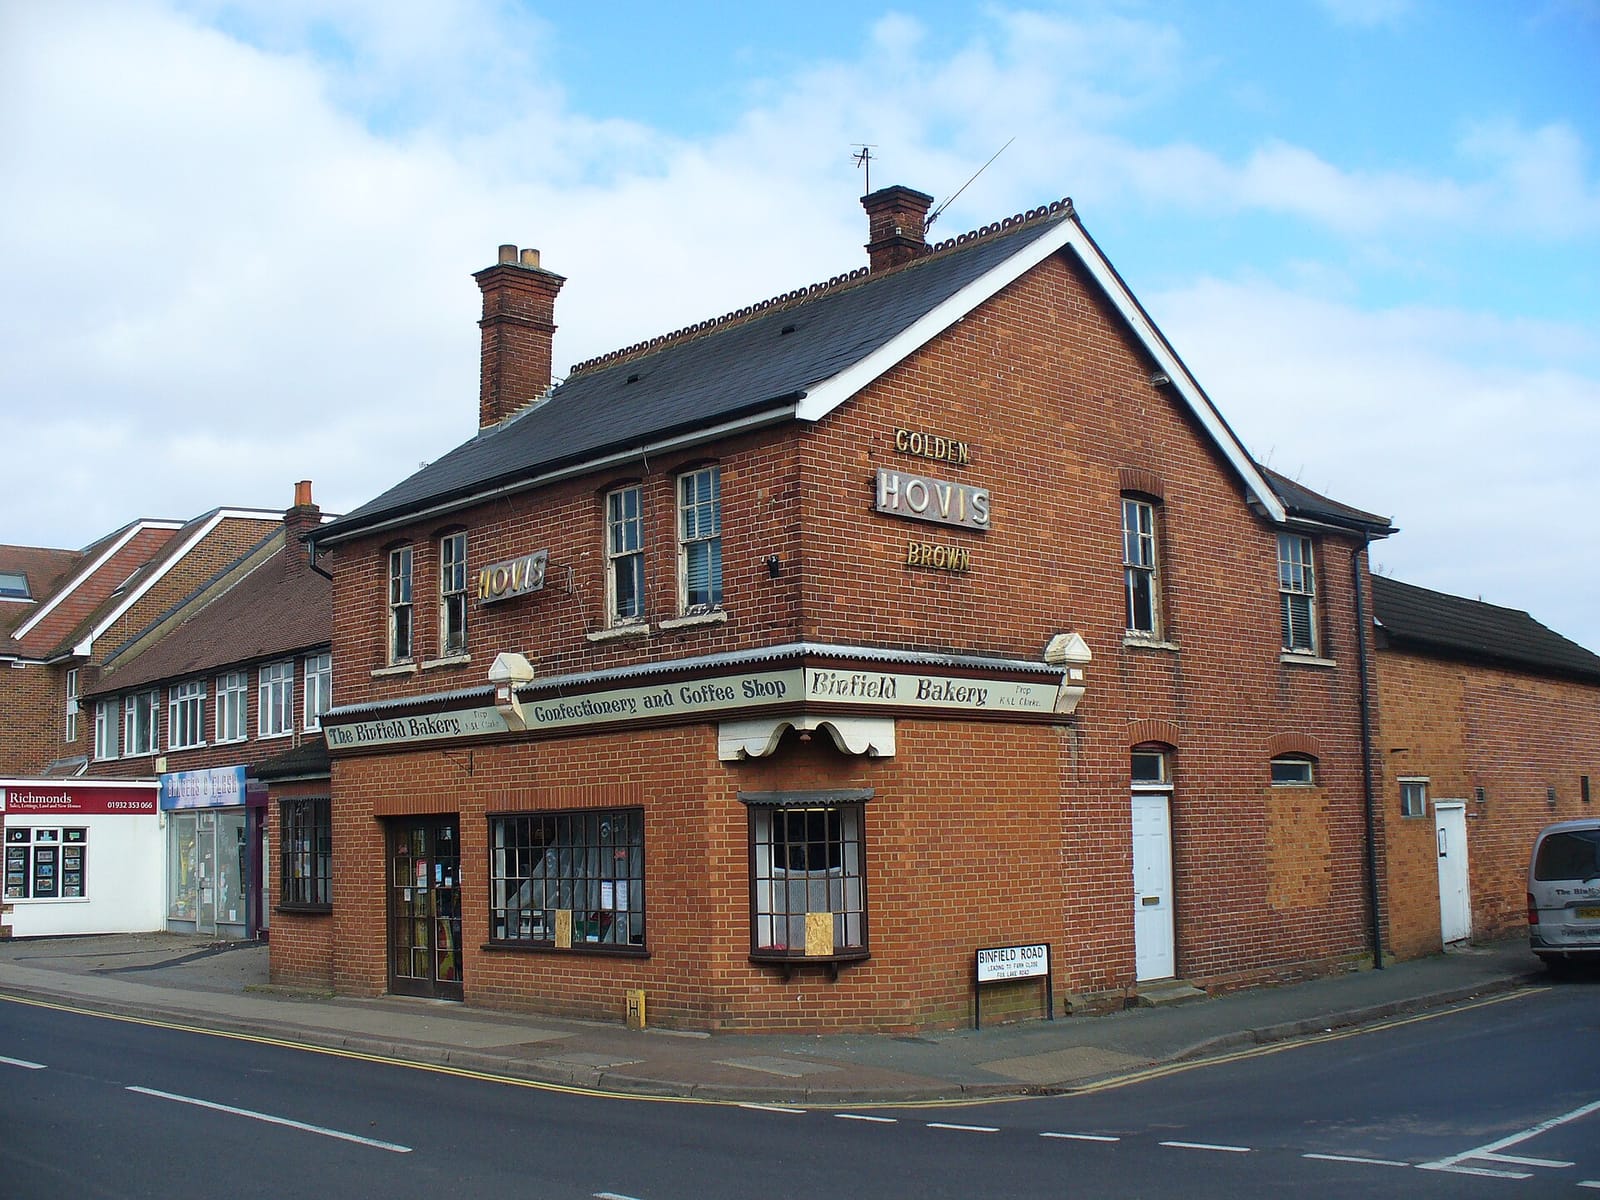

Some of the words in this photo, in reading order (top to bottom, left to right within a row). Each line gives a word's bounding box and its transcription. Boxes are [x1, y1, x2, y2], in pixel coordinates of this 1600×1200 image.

[895, 429, 969, 464] GOLDEN
[881, 472, 989, 525] HOVIS
[907, 541, 970, 571] BROWN
[478, 555, 546, 600] HOVIS
[534, 696, 638, 724] Confectionery
[643, 689, 674, 708] and
[679, 684, 735, 705] Coffee
[742, 678, 787, 699] Shop
[811, 672, 897, 699] Binfield
[915, 678, 989, 707] Bakery
[329, 727, 354, 745] The
[355, 719, 406, 742] Binfield
[408, 716, 462, 737] Bakery
[10, 791, 72, 804] Richmonds
[107, 801, 128, 809] 01932
[128, 801, 140, 809] 353
[979, 949, 1016, 963] BINFIELD
[1021, 946, 1044, 960] ROAD
[629, 999, 639, 1017] H
